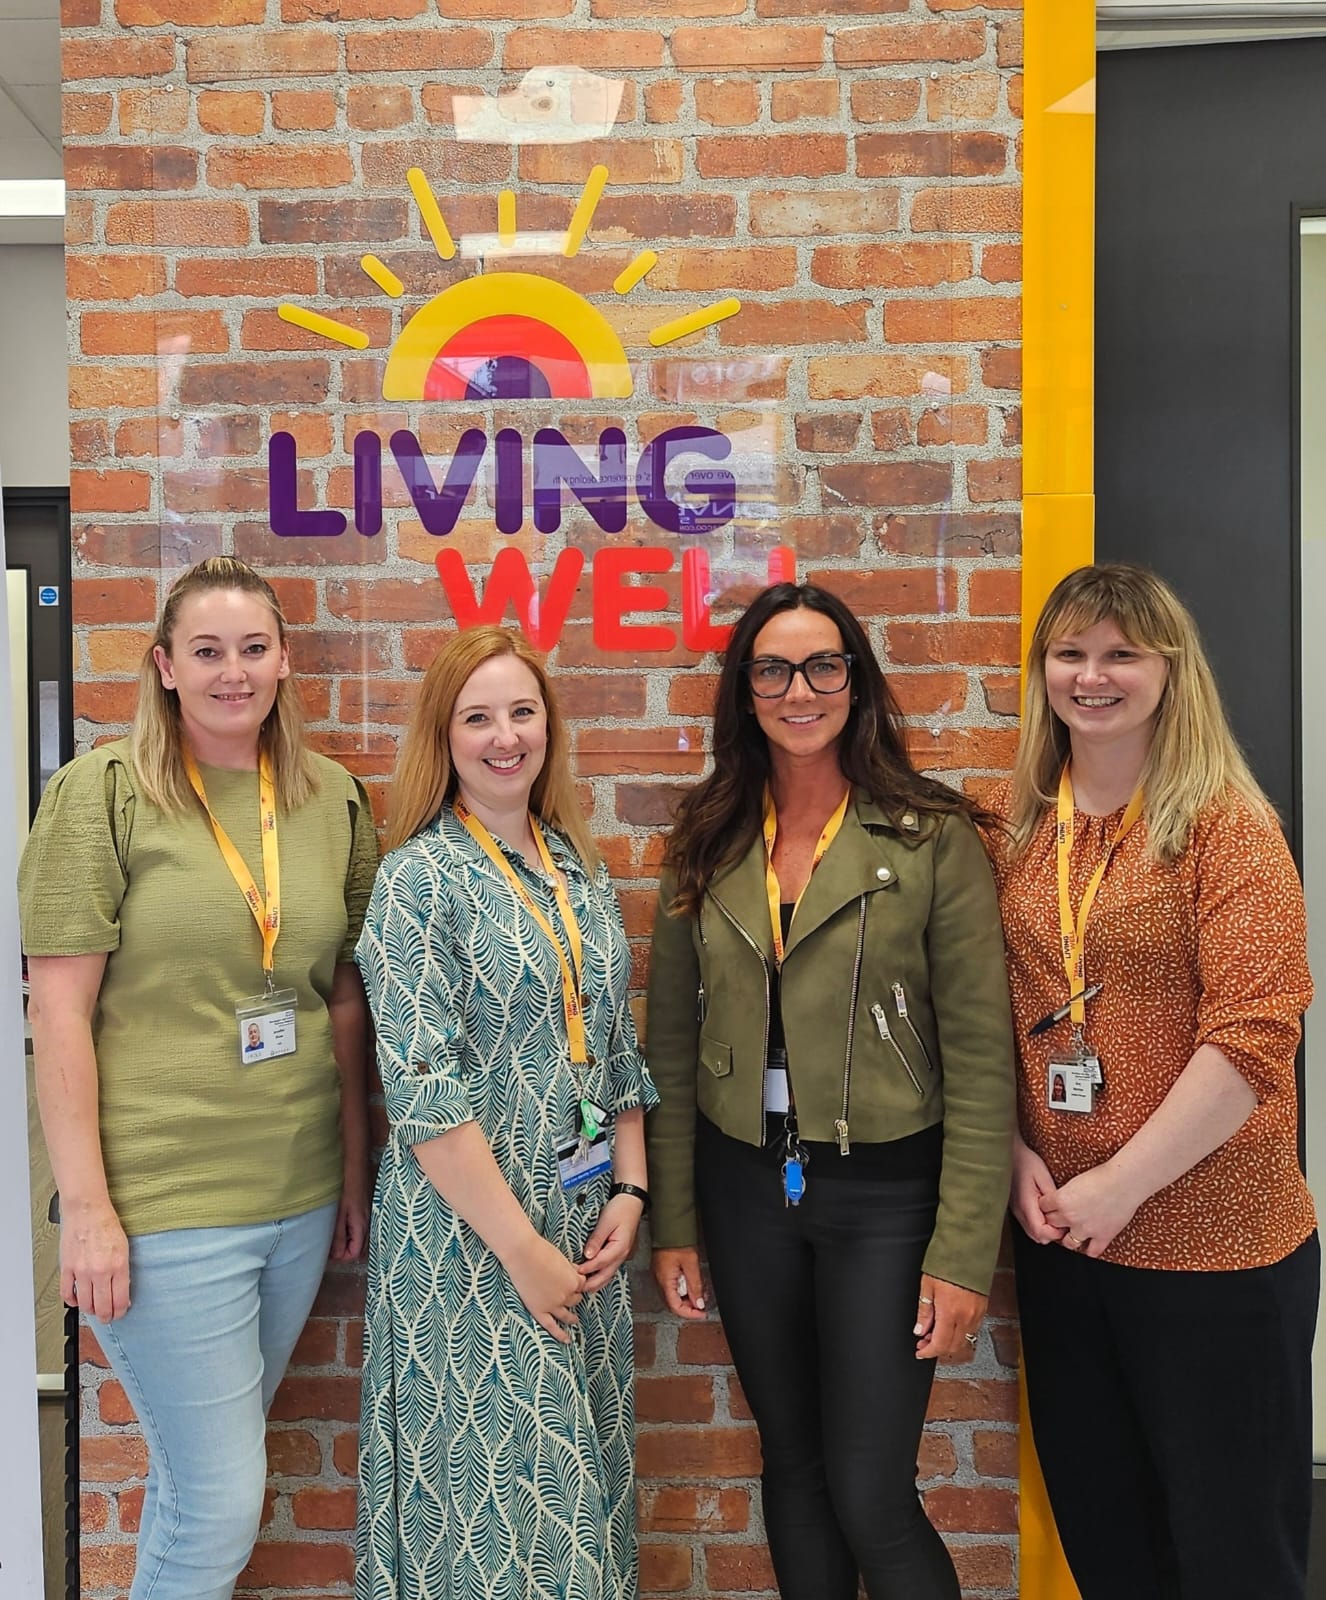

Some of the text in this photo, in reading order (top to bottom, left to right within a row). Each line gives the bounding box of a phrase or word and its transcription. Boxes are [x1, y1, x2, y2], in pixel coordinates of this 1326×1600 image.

[269, 426, 736, 536] LIVING
[435, 546, 796, 652] WEL
[245, 890, 259, 912] LIVING
[1063, 935, 1071, 959] LIVING
[566, 1001, 574, 1021] WELL
[570, 992, 578, 1016] LIVING
